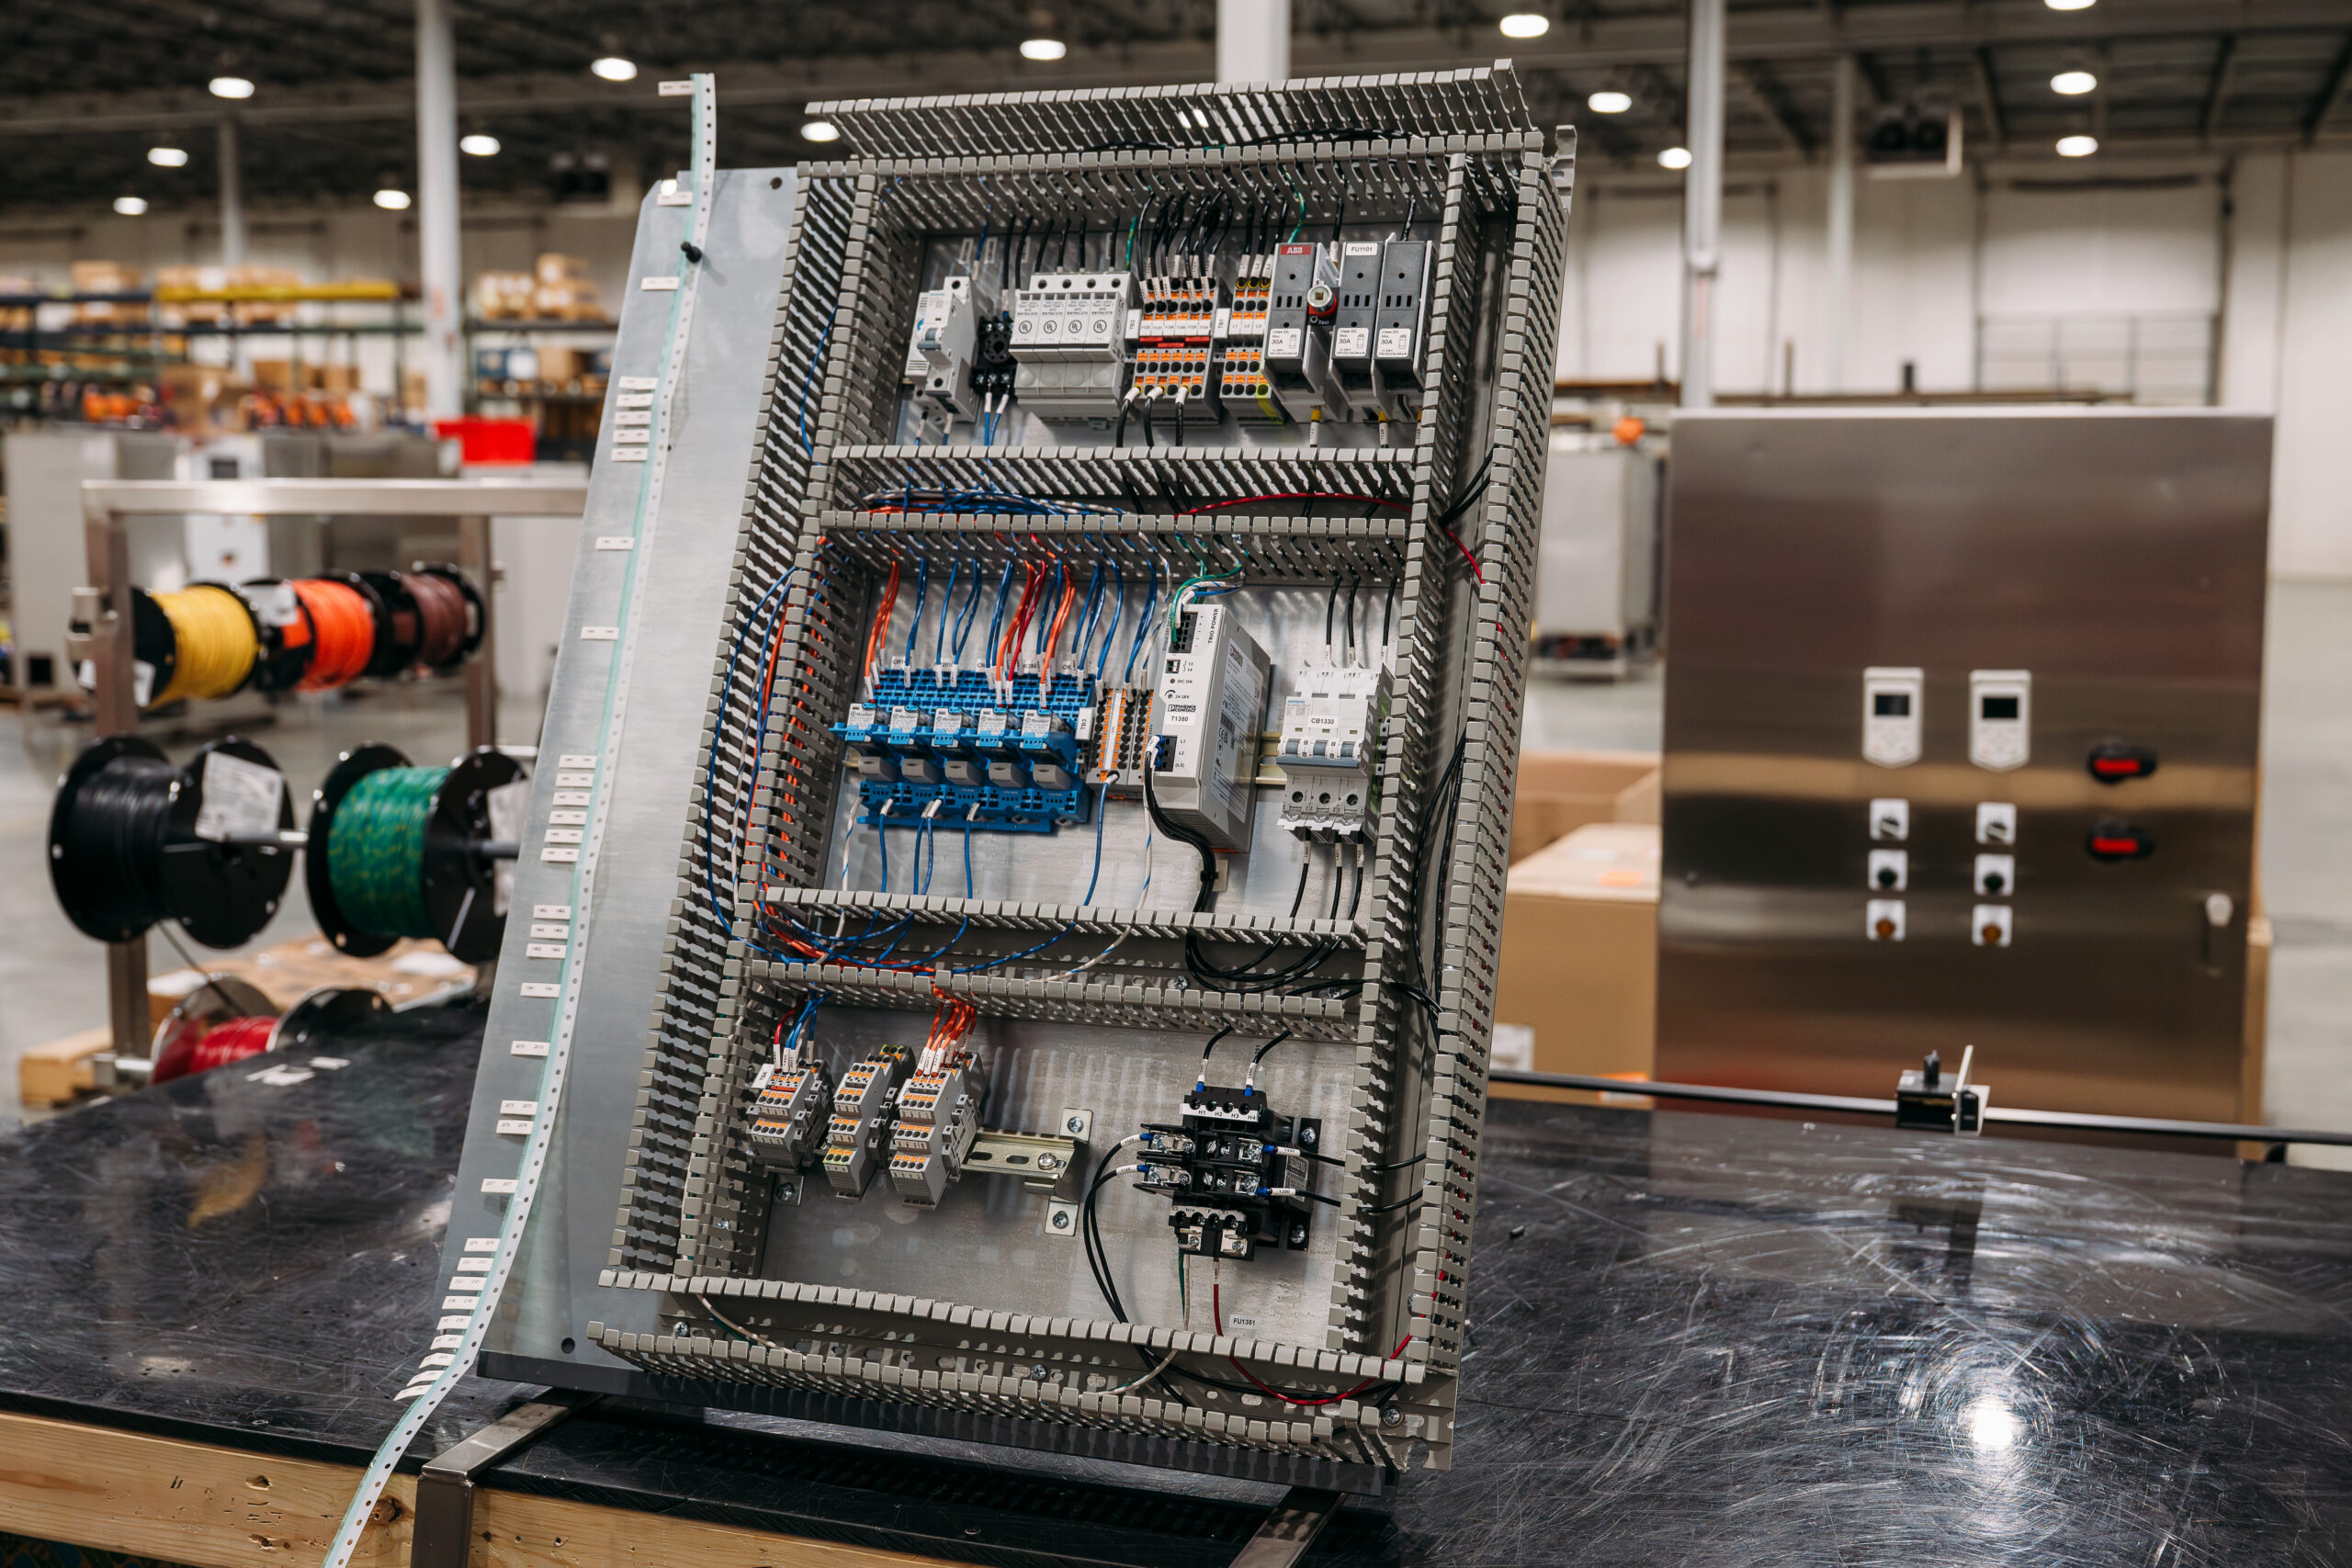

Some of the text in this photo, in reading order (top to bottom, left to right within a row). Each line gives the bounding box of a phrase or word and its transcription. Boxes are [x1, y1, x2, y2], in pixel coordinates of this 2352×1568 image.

[1286, 246, 1303, 254] ABB
[1210, 609, 1219, 629] POWER
[1233, 1318, 1255, 1326] FU1351
